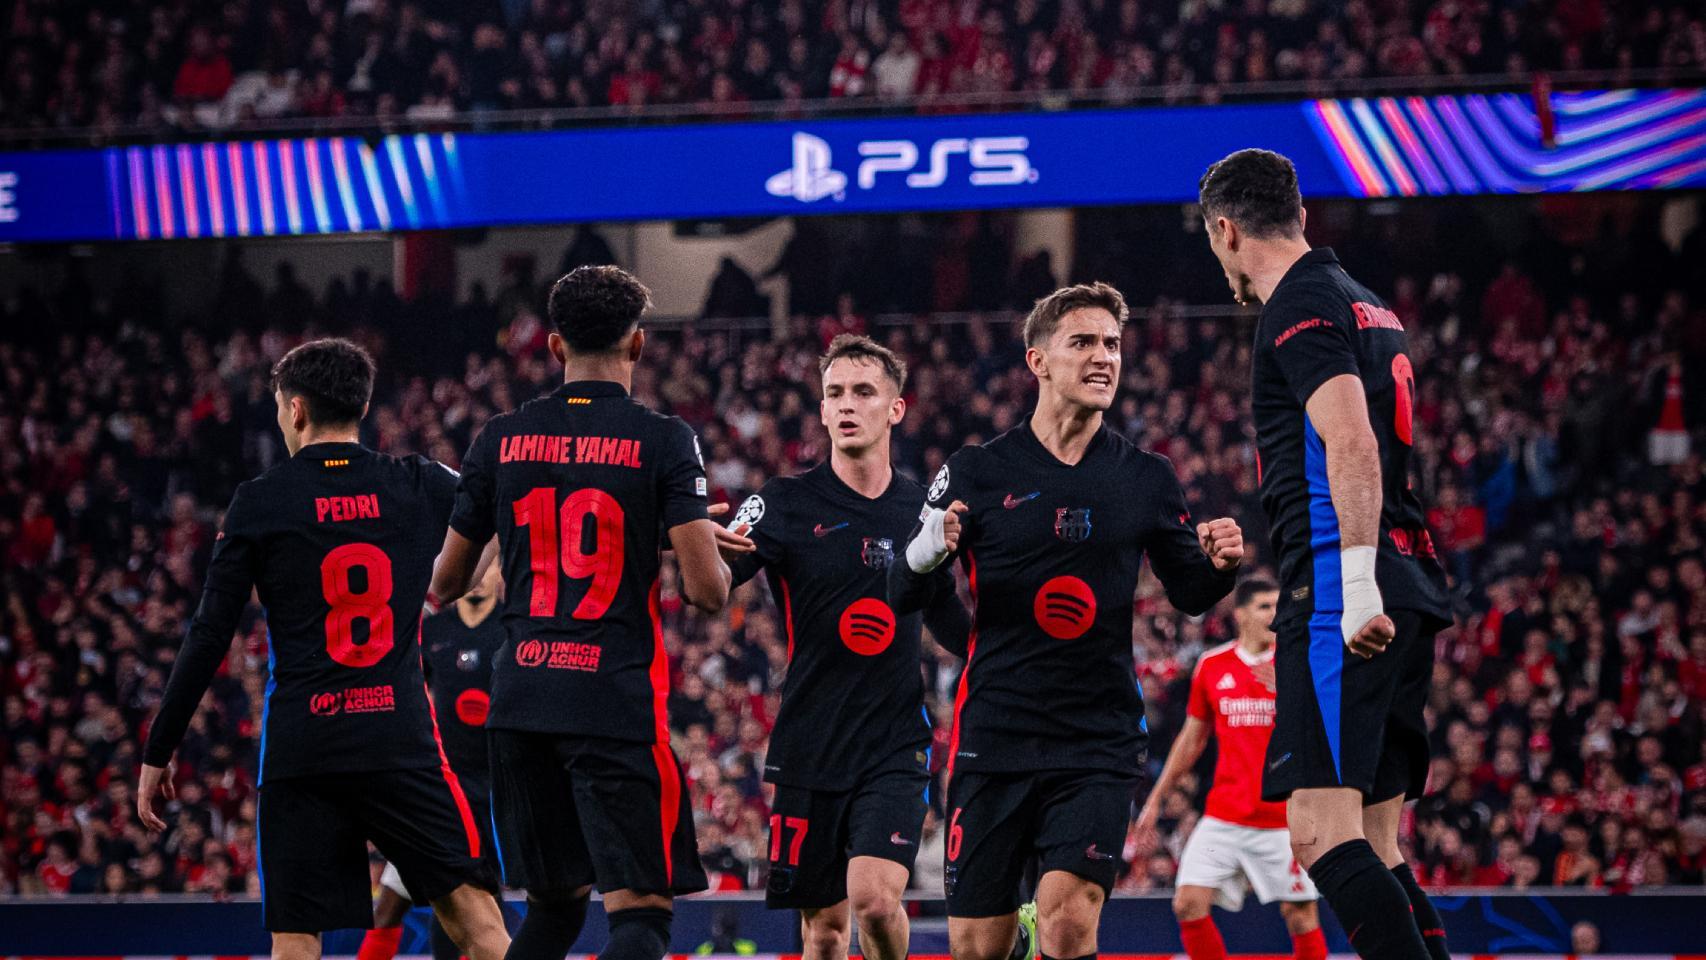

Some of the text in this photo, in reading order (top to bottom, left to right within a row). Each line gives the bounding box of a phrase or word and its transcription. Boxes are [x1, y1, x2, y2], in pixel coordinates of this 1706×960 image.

[858, 136, 1031, 190] PS5
[500, 434, 643, 469] LAMINE YAMAL
[315, 494, 380, 523] PEDRI
[512, 487, 625, 620] 19
[320, 542, 394, 668] 8
[547, 653, 600, 668] ACNUR
[550, 641, 601, 657] UNHCR
[344, 685, 394, 699] UNHCR
[345, 696, 395, 709] ACNUR
[770, 814, 808, 866] 17
[947, 807, 963, 862] 6
